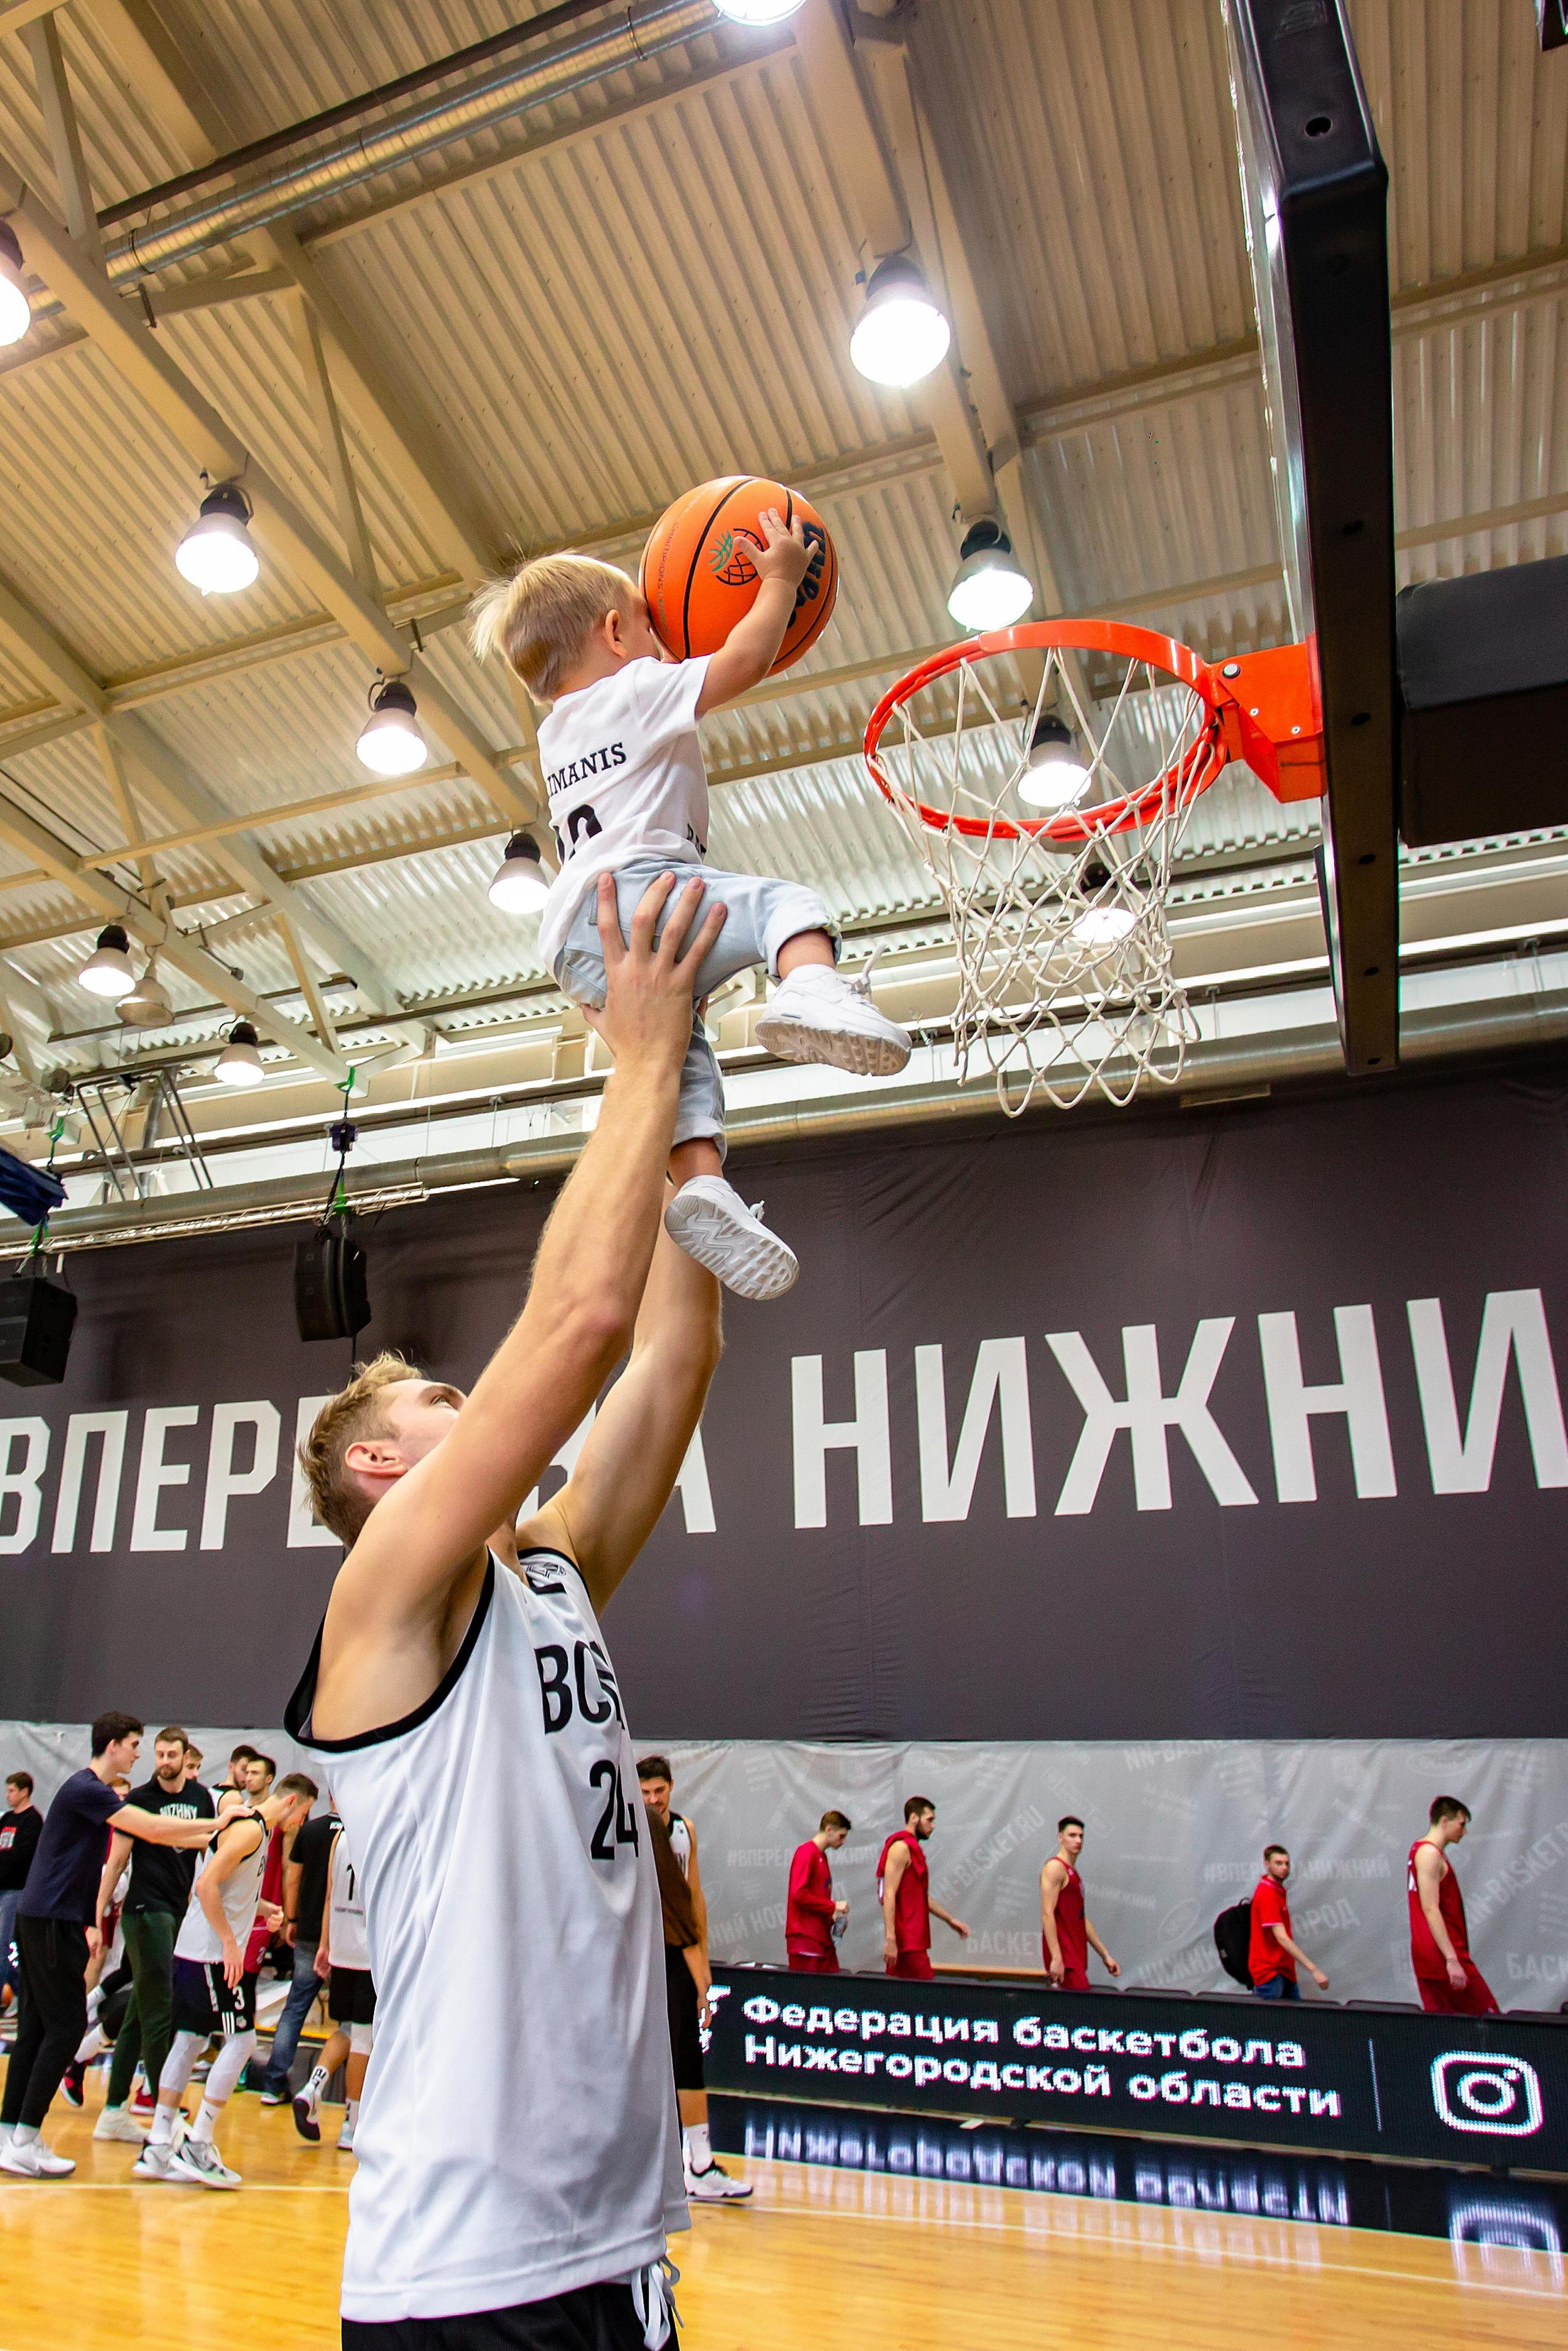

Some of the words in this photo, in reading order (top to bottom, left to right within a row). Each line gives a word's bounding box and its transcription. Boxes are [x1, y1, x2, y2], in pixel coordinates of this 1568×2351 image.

[589, 1760, 639, 1860] 24
[232, 1985, 245, 2010] 3
[742, 1995, 1000, 2044] Федерация
[1012, 2016, 1306, 2068] баскетбола
[744, 2033, 1112, 2096] Нижегородской
[1128, 2070, 1342, 2118] области
